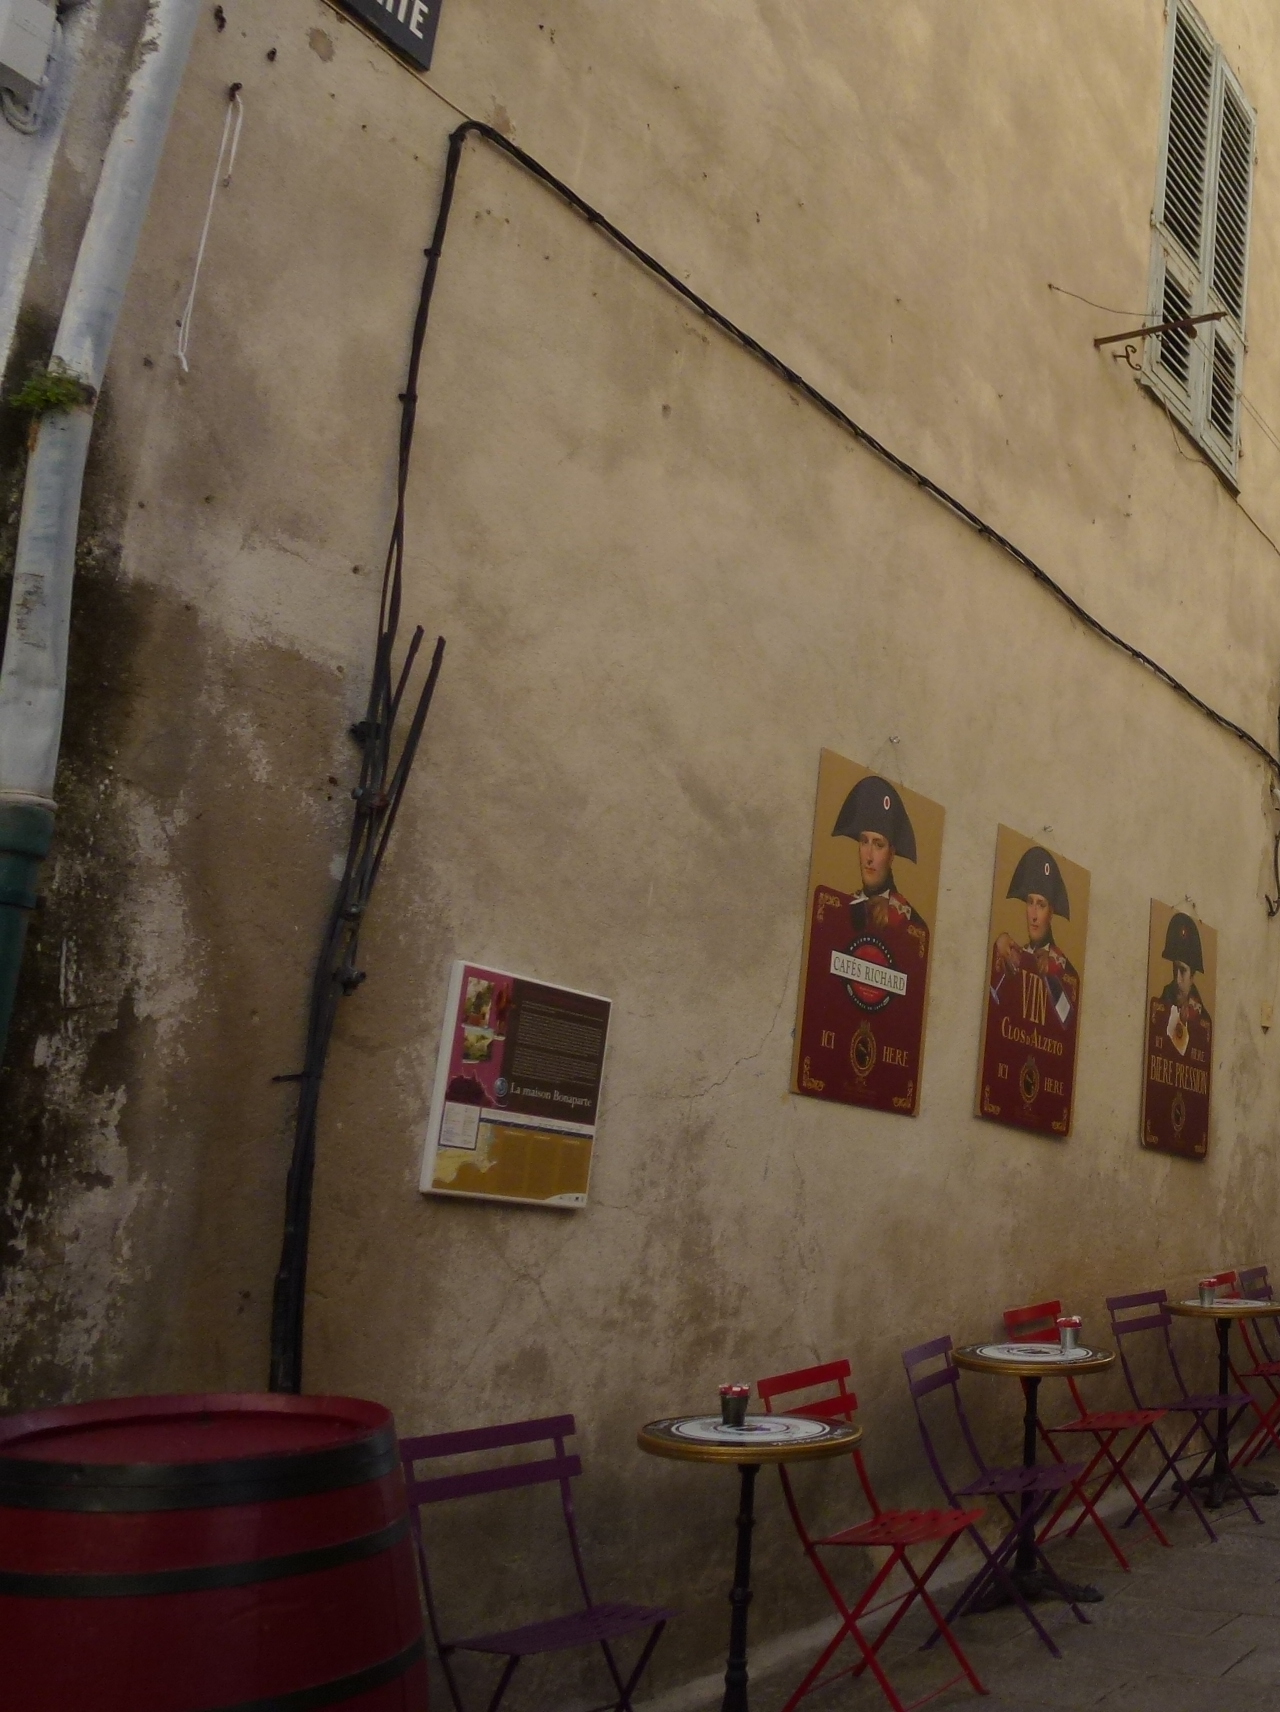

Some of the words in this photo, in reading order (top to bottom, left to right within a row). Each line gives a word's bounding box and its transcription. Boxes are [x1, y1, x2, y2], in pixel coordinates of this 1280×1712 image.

[833, 956, 861, 978] CAFÉS
[864, 965, 906, 991] RICHARD
[1021, 969, 1047, 1026] VIN
[821, 1029, 836, 1049] ICI
[882, 1046, 909, 1067] HERE
[998, 1061, 1009, 1080] ICI
[1175, 1062, 1208, 1095] PRESSION
[510, 1082, 521, 1094] La
[522, 1086, 552, 1100] maison
[552, 1089, 593, 1108] Bonaparte
[1044, 1077, 1064, 1096] HERE
